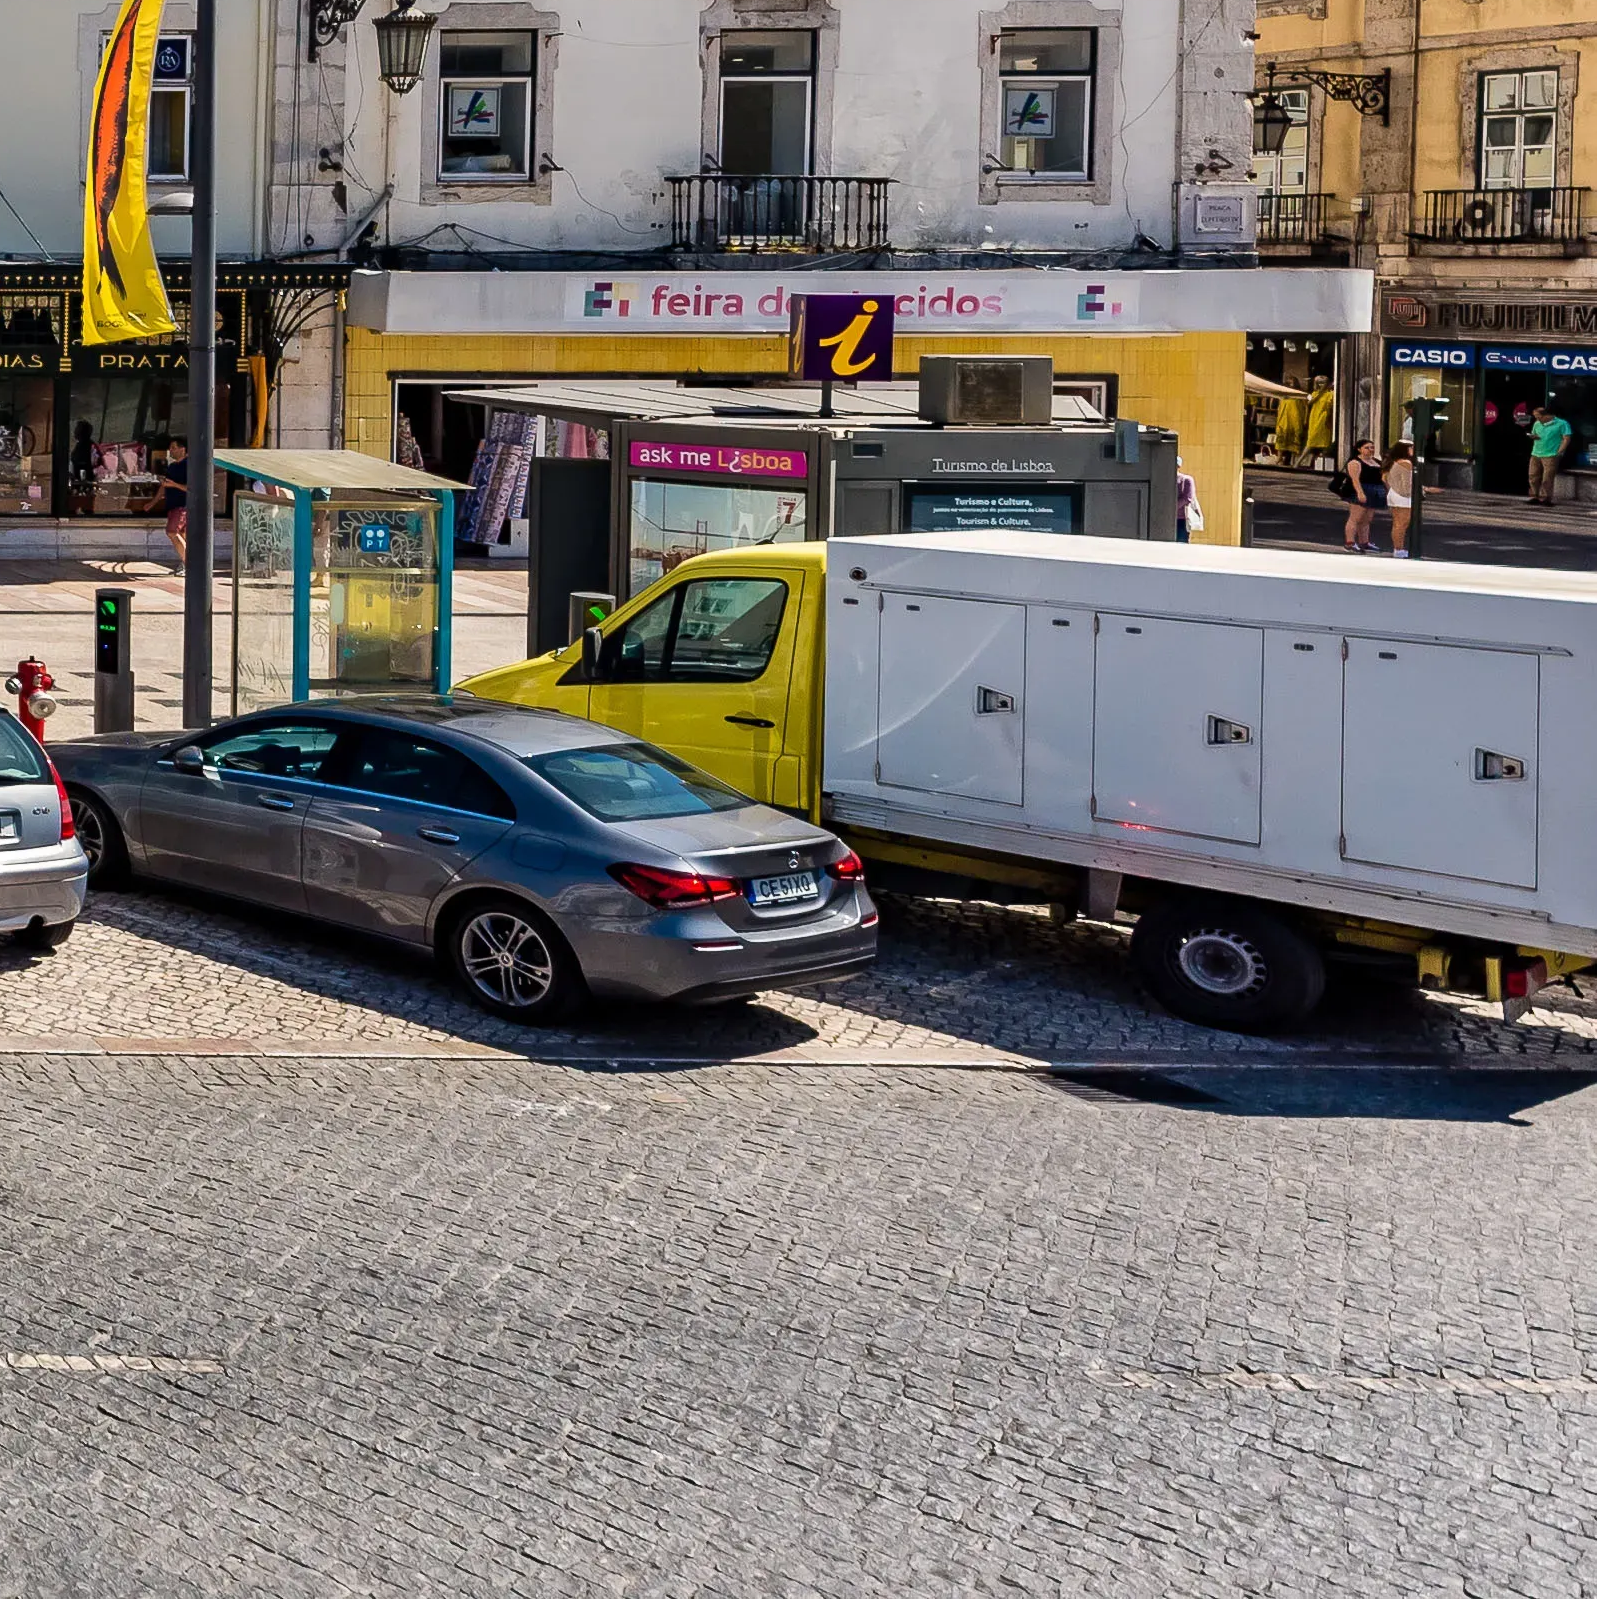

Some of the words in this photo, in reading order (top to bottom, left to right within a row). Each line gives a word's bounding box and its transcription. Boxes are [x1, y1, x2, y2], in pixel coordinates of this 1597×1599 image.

[651, 284, 744, 318] feira
[1433, 303, 1597, 332] FUJIFILM
[99, 354, 189, 369] PRATA
[1394, 348, 1467, 365] CASIO
[639, 446, 673, 464] ask
[680, 451, 711, 466] me
[932, 458, 988, 473] Turismo
[991, 458, 1008, 473] de
[1012, 458, 1055, 473] Lisboa
[954, 497, 990, 506] Turismo
[956, 516, 989, 525] Tourism
